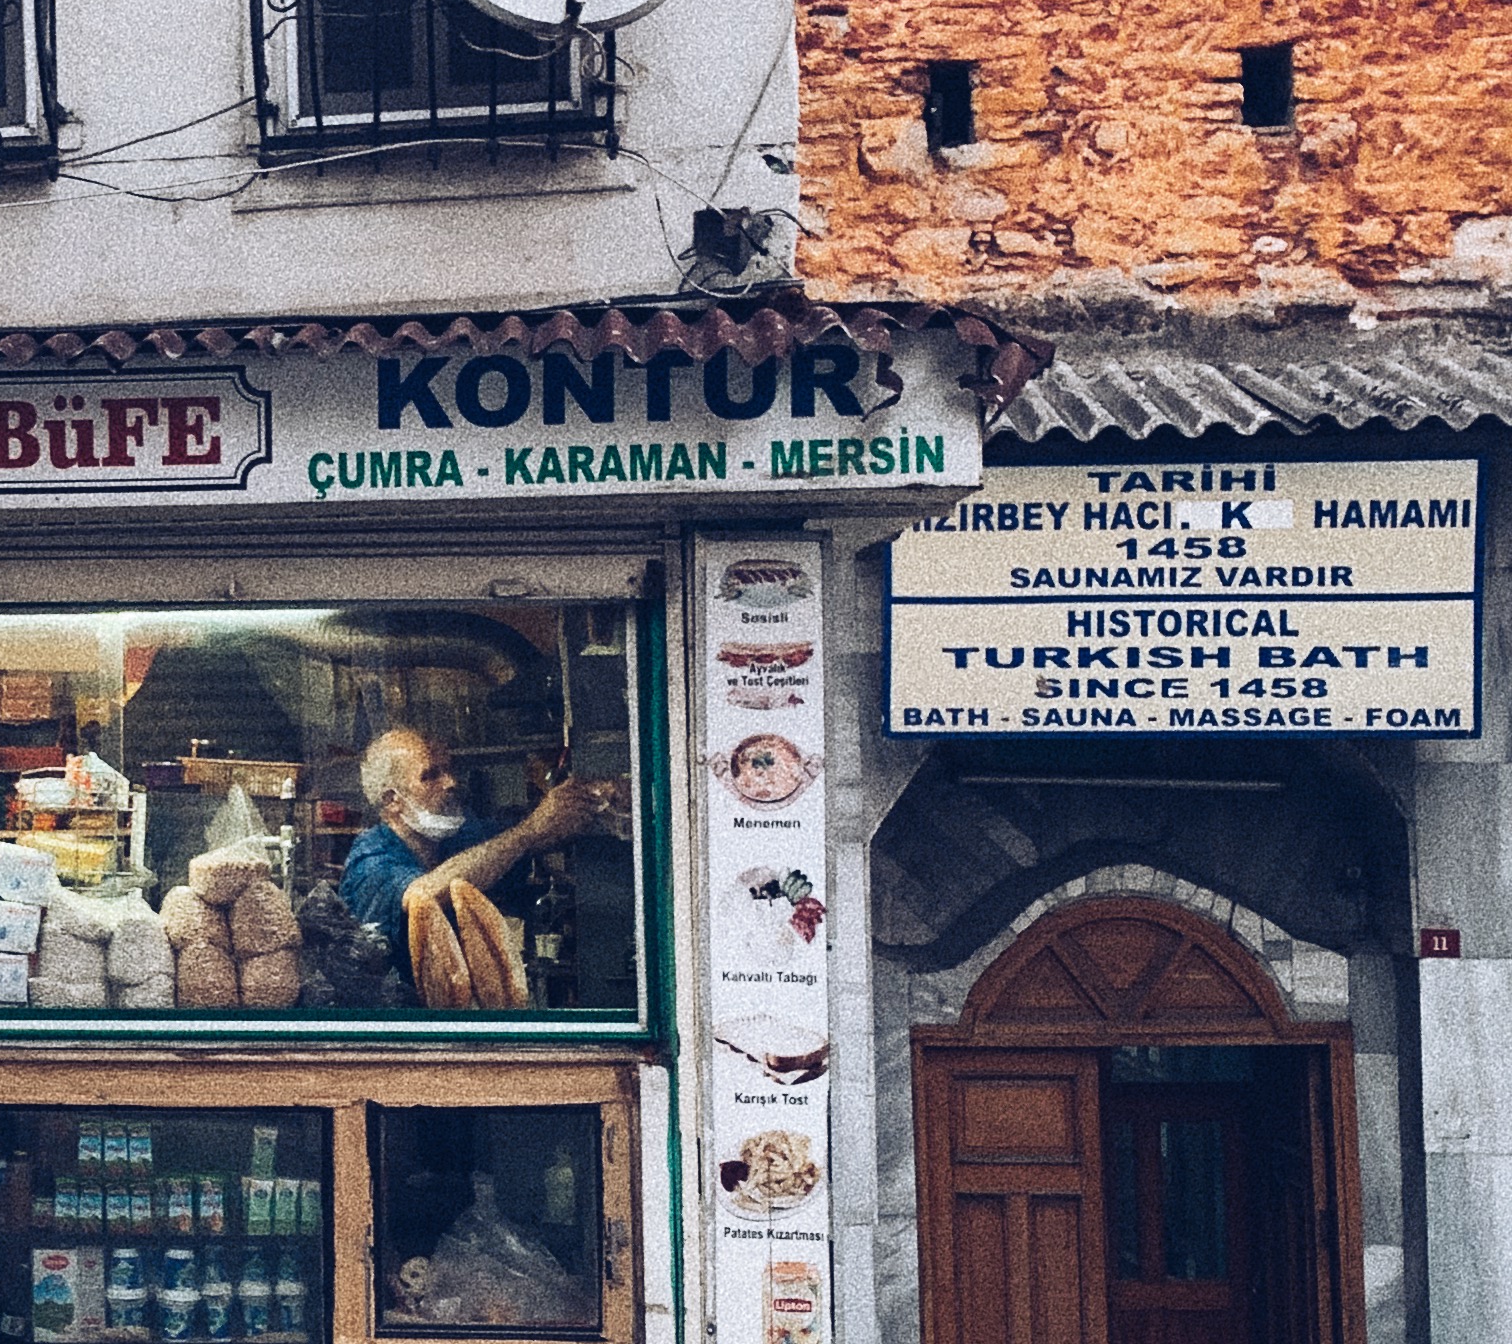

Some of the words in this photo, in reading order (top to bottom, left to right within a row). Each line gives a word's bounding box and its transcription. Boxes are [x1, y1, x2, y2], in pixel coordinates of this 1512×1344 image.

[376, 344, 865, 431] KONTUR
[307, 449, 464, 500] ÇUMRA
[504, 441, 727, 485] KARAMAN
[770, 426, 945, 477] MERSİN
[1088, 465, 1277, 492] TARİHİ
[1221, 501, 1254, 530] K
[1313, 498, 1471, 529] HAMAMI
[1116, 536, 1247, 560] 1458
[1009, 566, 1202, 589] SAUNAMIZ
[1215, 566, 1354, 587] VARDIR
[1067, 609, 1299, 638] HISTORICAL
[942, 646, 1231, 670] TURKISH
[1258, 646, 1428, 669] BATH
[1035, 677, 1189, 699] SINCE
[1210, 677, 1328, 699] 1458
[903, 707, 989, 727] BATH
[1021, 707, 1136, 727] SAUNA
[1168, 707, 1333, 727] MASSAGE
[1366, 707, 1462, 728] FOAM
[733, 817, 801, 829] Menemen
[1432, 936, 1448, 951] 11
[722, 971, 773, 984] Kahvaltı
[777, 971, 818, 985] Tabağı
[734, 1092, 778, 1106] Karışık
[781, 1093, 808, 1106] Tost
[724, 1227, 764, 1240] Patates
[774, 1300, 812, 1312] Lipton
